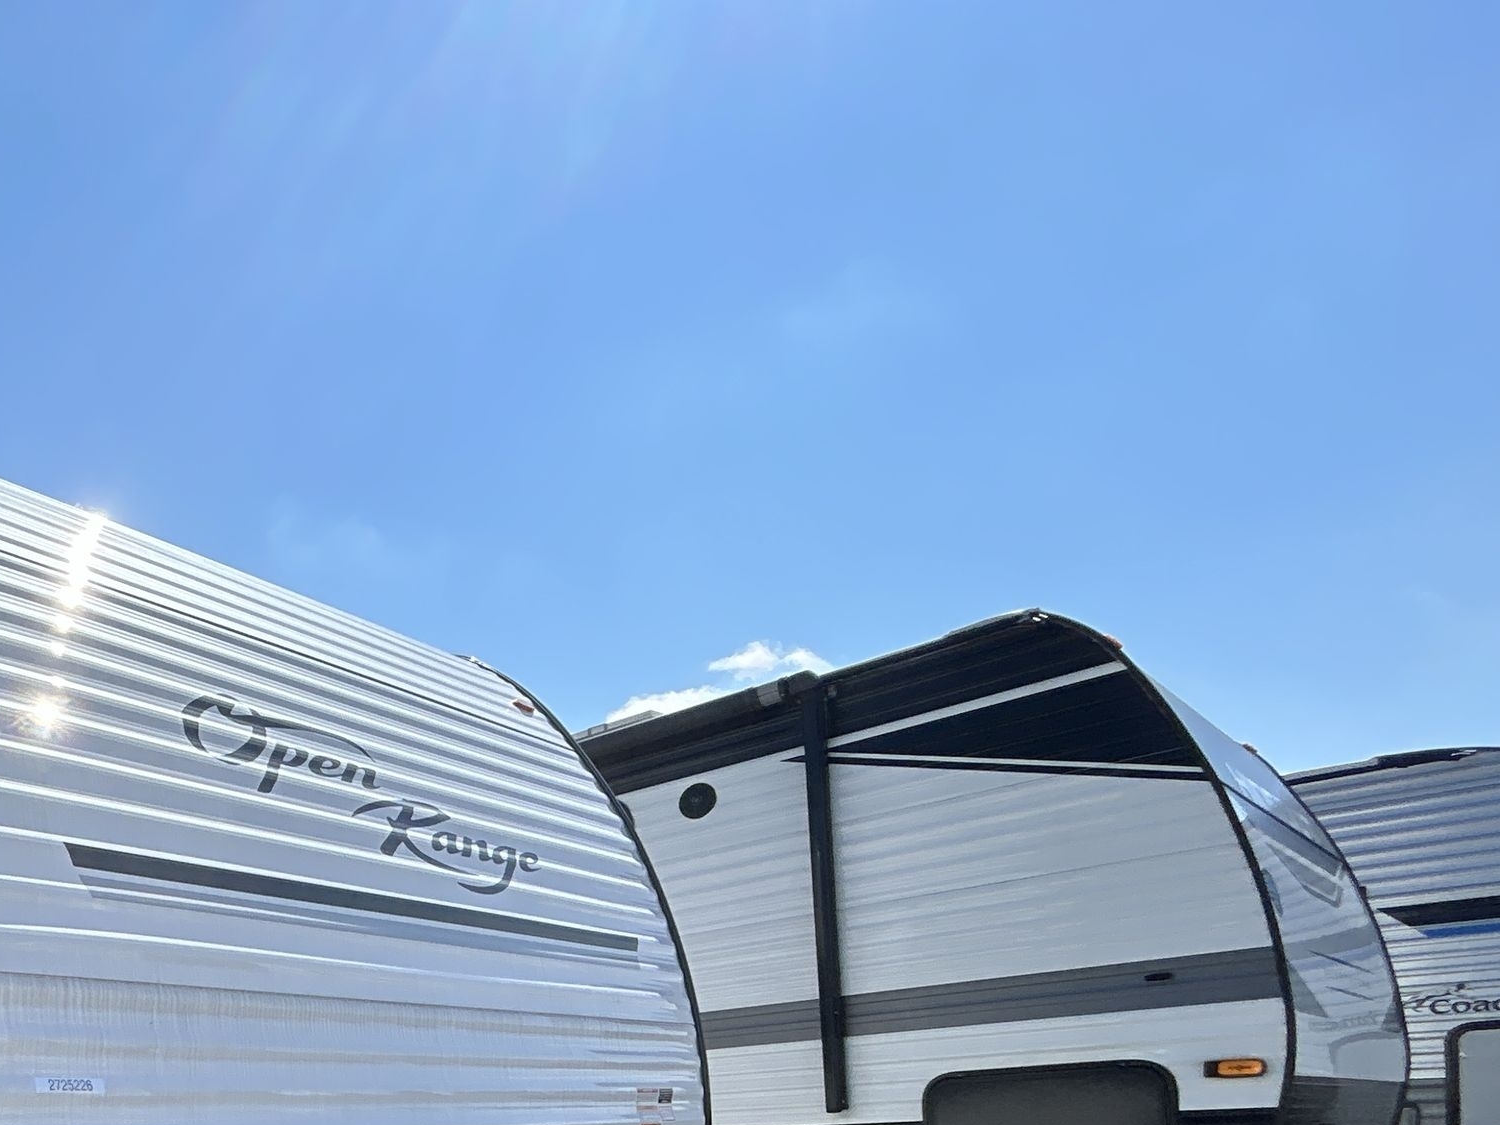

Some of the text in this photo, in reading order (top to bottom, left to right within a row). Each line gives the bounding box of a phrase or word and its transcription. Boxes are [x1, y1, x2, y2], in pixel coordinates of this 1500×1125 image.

[181, 693, 381, 793] Open
[351, 798, 543, 895] Range
[47, 1078, 94, 1092] 2725226
